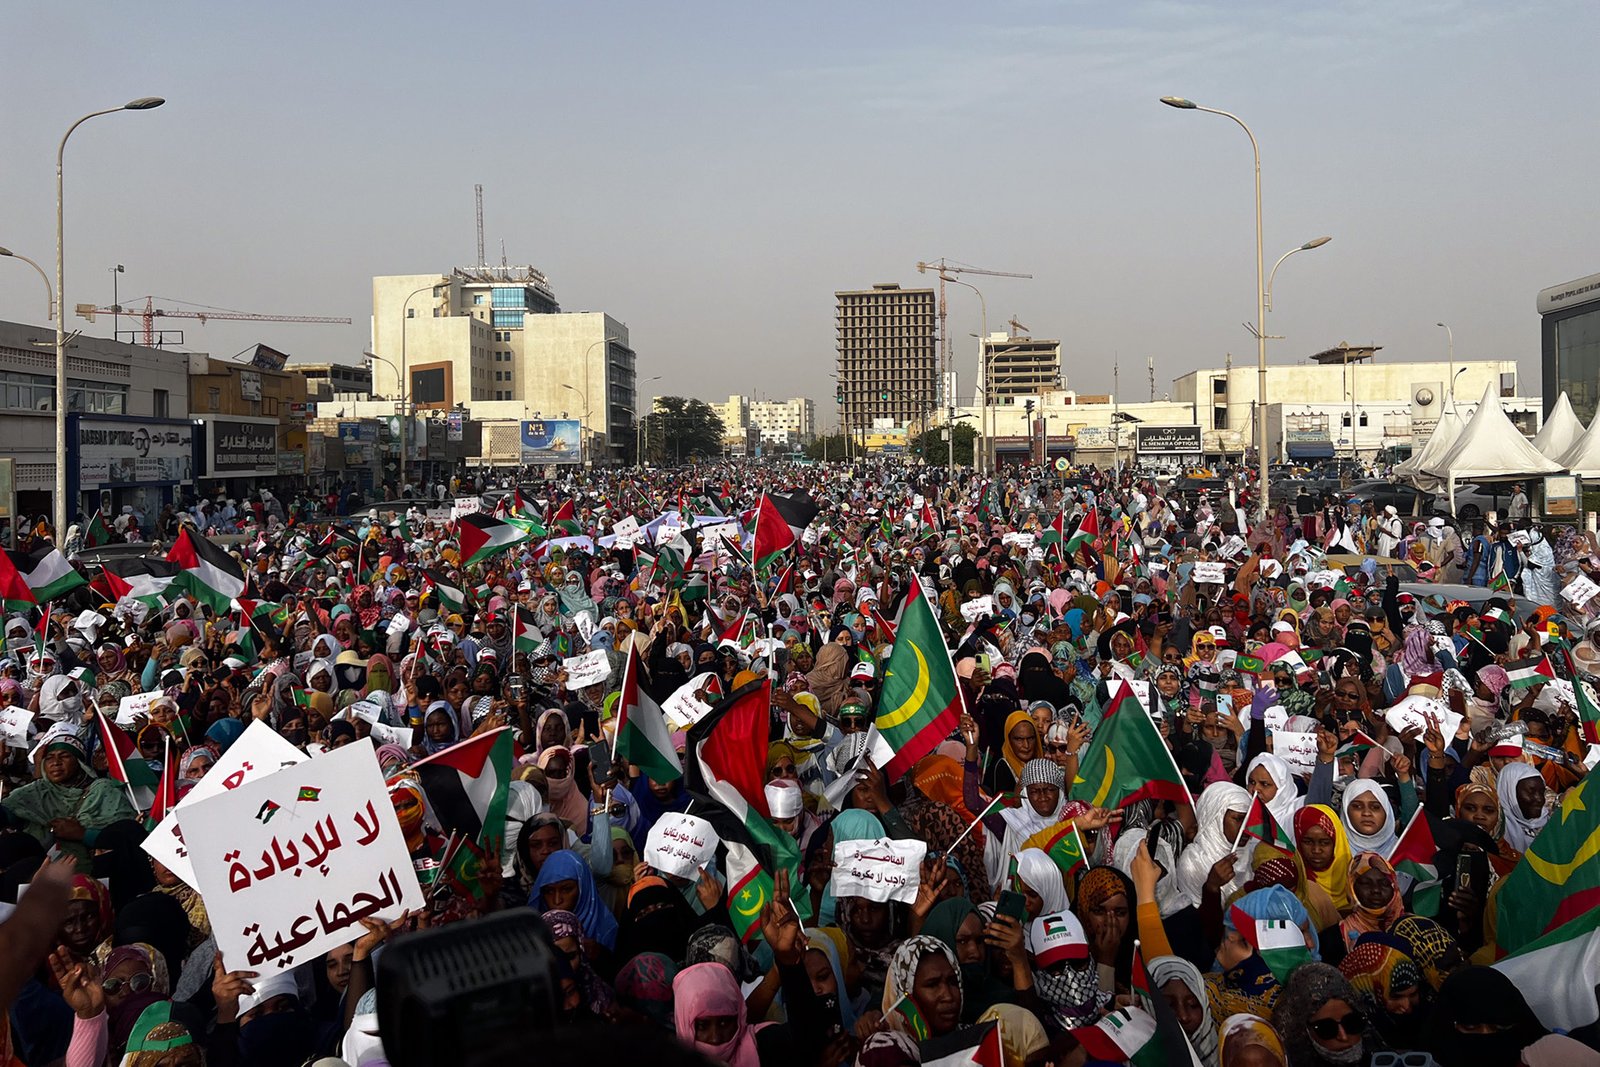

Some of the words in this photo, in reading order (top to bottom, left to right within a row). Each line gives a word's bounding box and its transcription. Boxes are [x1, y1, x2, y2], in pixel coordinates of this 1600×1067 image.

[1289, 745, 1311, 755] موريتانيا
[354, 800, 380, 846] لا
[663, 827, 689, 843] موريتانيا
[691, 836, 705, 847] نساء
[223, 814, 342, 893] للإبادة
[673, 849, 691, 860] طوفان
[690, 856, 698, 864] مع
[851, 867, 874, 880] مكرمة
[875, 872, 883, 883] لا
[884, 875, 906, 888] واجب
[1044, 932, 1072, 943] PALESTINE
